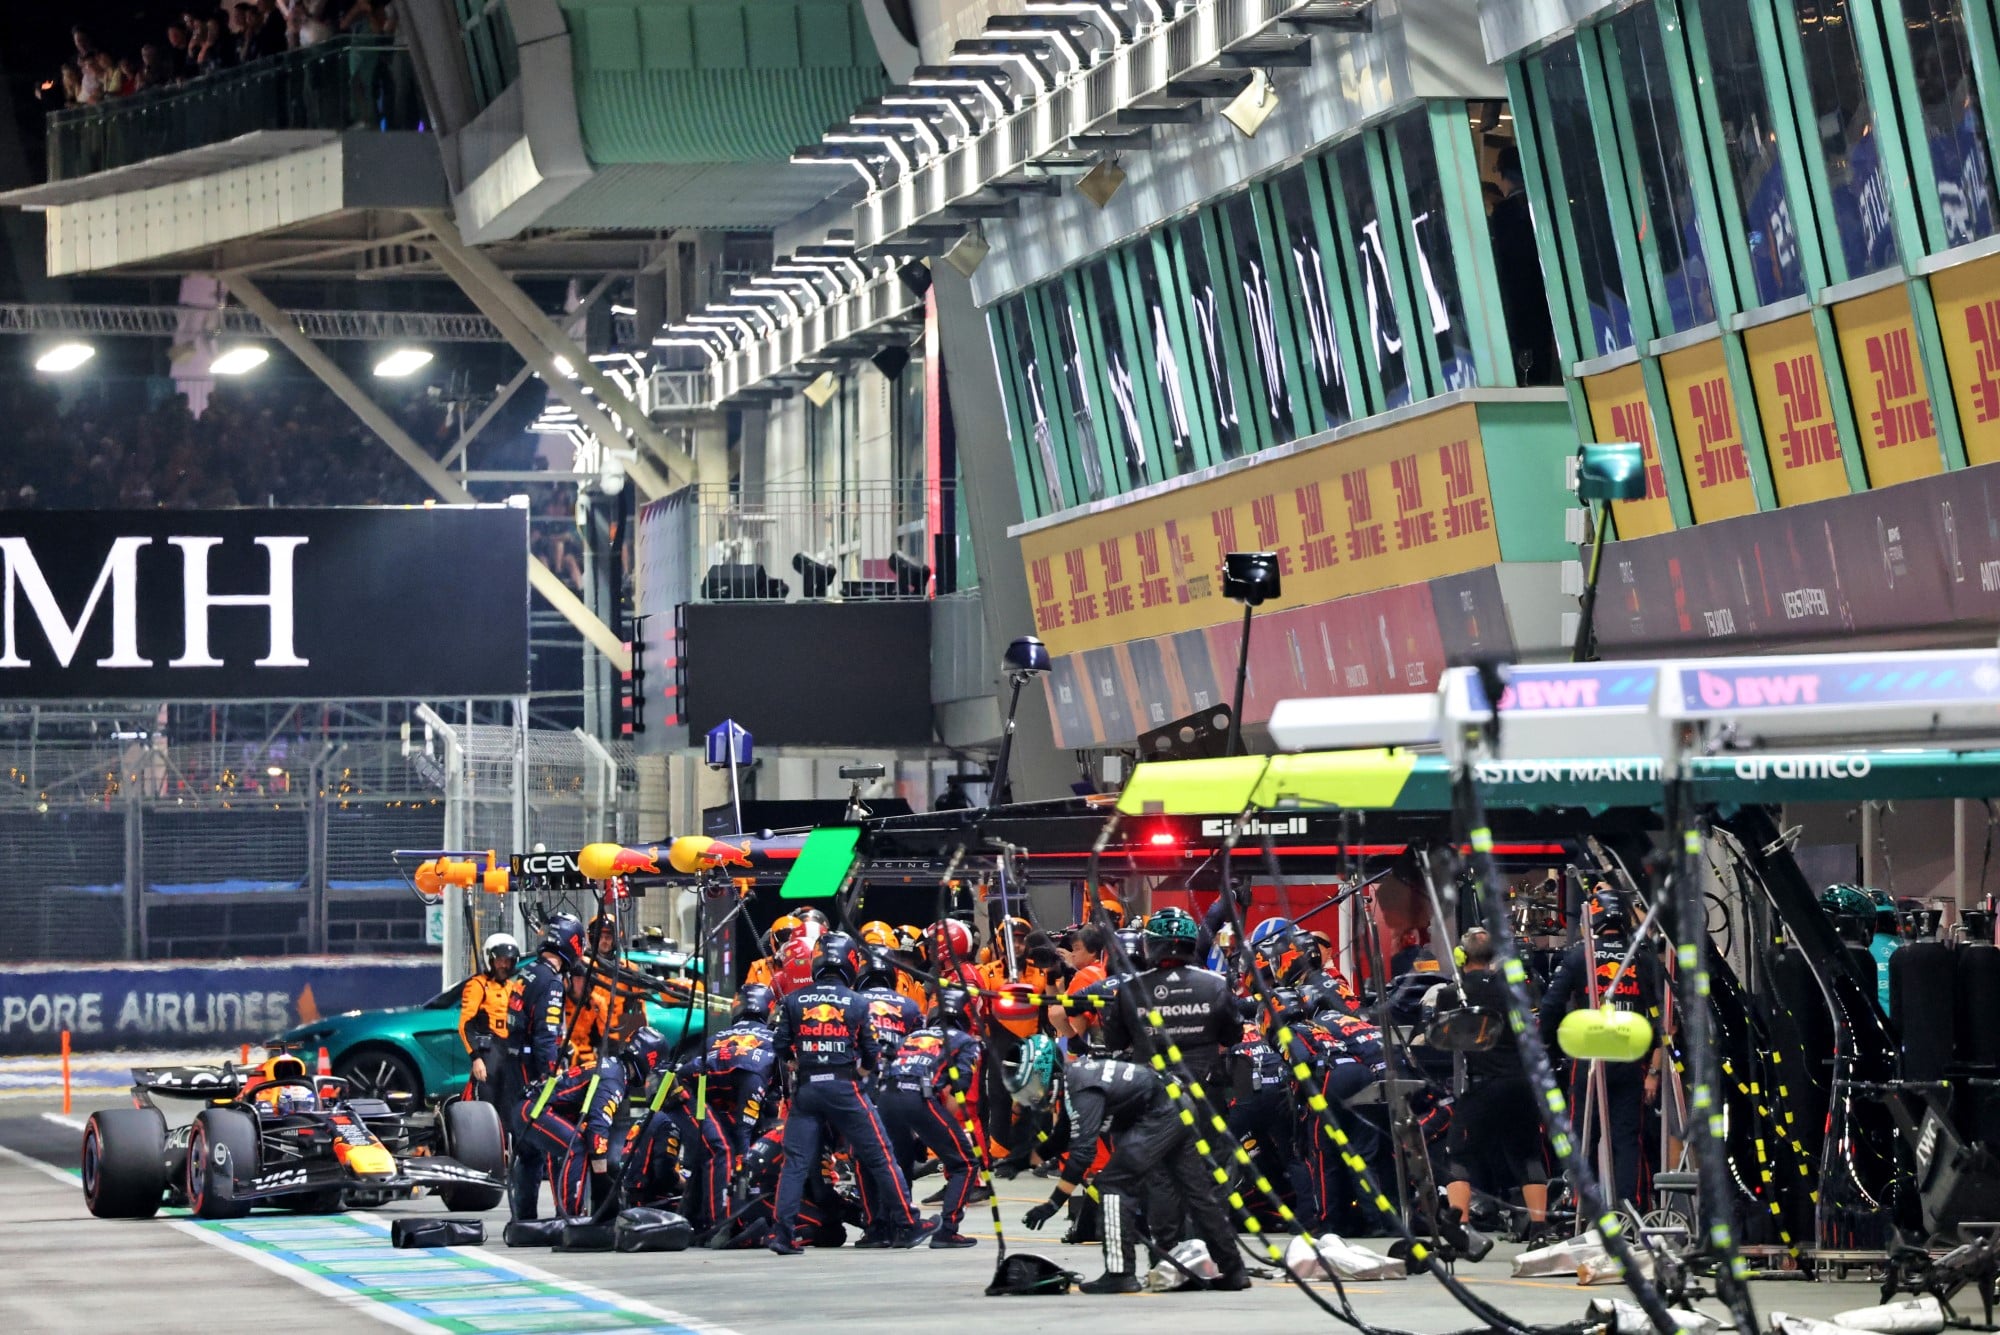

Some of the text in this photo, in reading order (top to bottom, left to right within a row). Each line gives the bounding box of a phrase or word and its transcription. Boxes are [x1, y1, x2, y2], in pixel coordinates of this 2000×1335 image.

[0, 536, 309, 667] MH
[1781, 588, 1829, 619] VERSTAPPEN
[1704, 608, 1736, 637] TSUNODA
[1516, 679, 1599, 708] BWT
[1735, 674, 1819, 704] BWT
[1474, 765, 1562, 784] ASTON
[1735, 754, 1871, 780] aramco
[1593, 951, 1634, 960] ORAC
[798, 994, 852, 1005] ORACLE
[863, 993, 905, 1003] RACLE
[1137, 1003, 1211, 1017] PTRONAS
[115, 991, 290, 1033] AIRLINES
[799, 1023, 822, 1036] Red
[802, 1041, 845, 1053] Mobil 1
[1916, 1118, 1938, 1166] IWC
[251, 1168, 307, 1190] VISA
